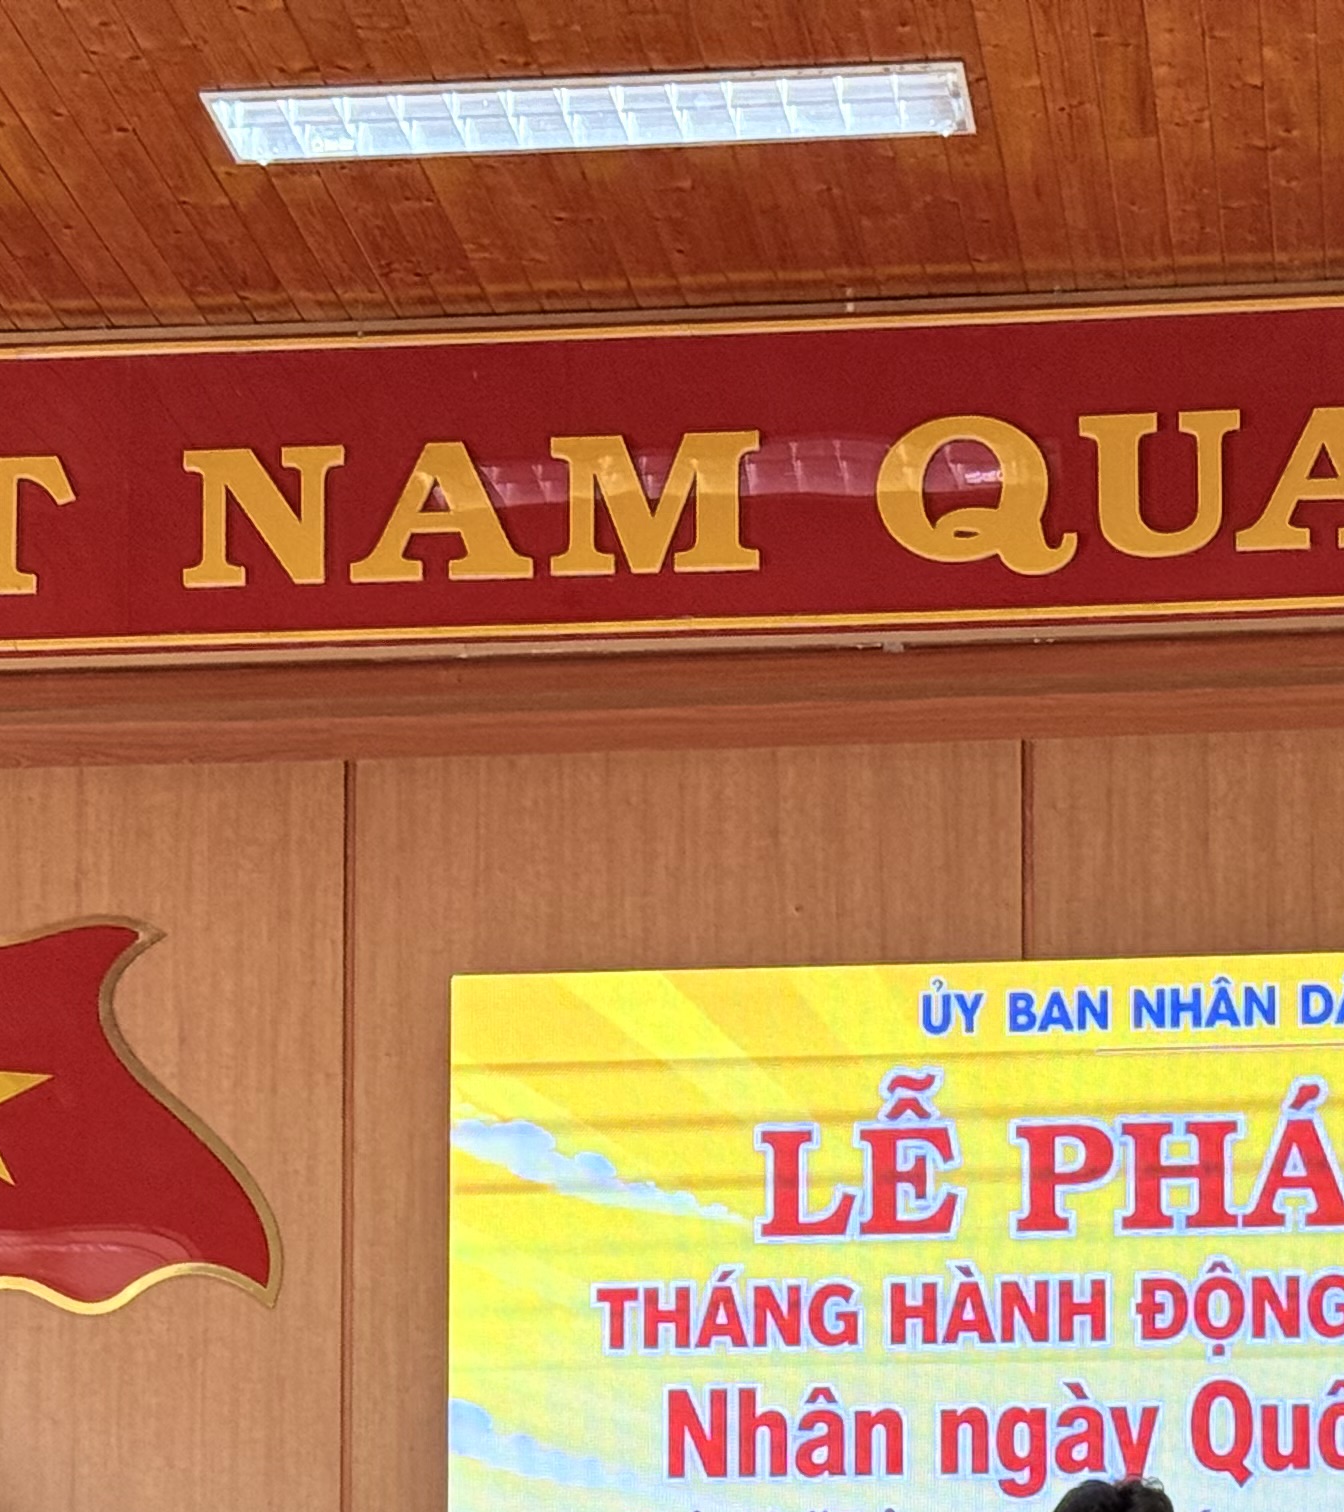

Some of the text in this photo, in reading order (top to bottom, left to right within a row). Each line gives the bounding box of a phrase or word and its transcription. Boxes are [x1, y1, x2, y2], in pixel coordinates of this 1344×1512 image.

[181, 429, 761, 589] NAM
[921, 979, 983, 1034] ỦY
[1009, 990, 1108, 1033] BAN
[1133, 976, 1276, 1029] NHÂN
[760, 1074, 959, 1236] LỄ
[597, 1270, 858, 1349] THÁNG
[890, 1265, 1105, 1345] HÀNH
[667, 1386, 905, 1477] Nhân
[940, 1381, 1158, 1498] ngày
